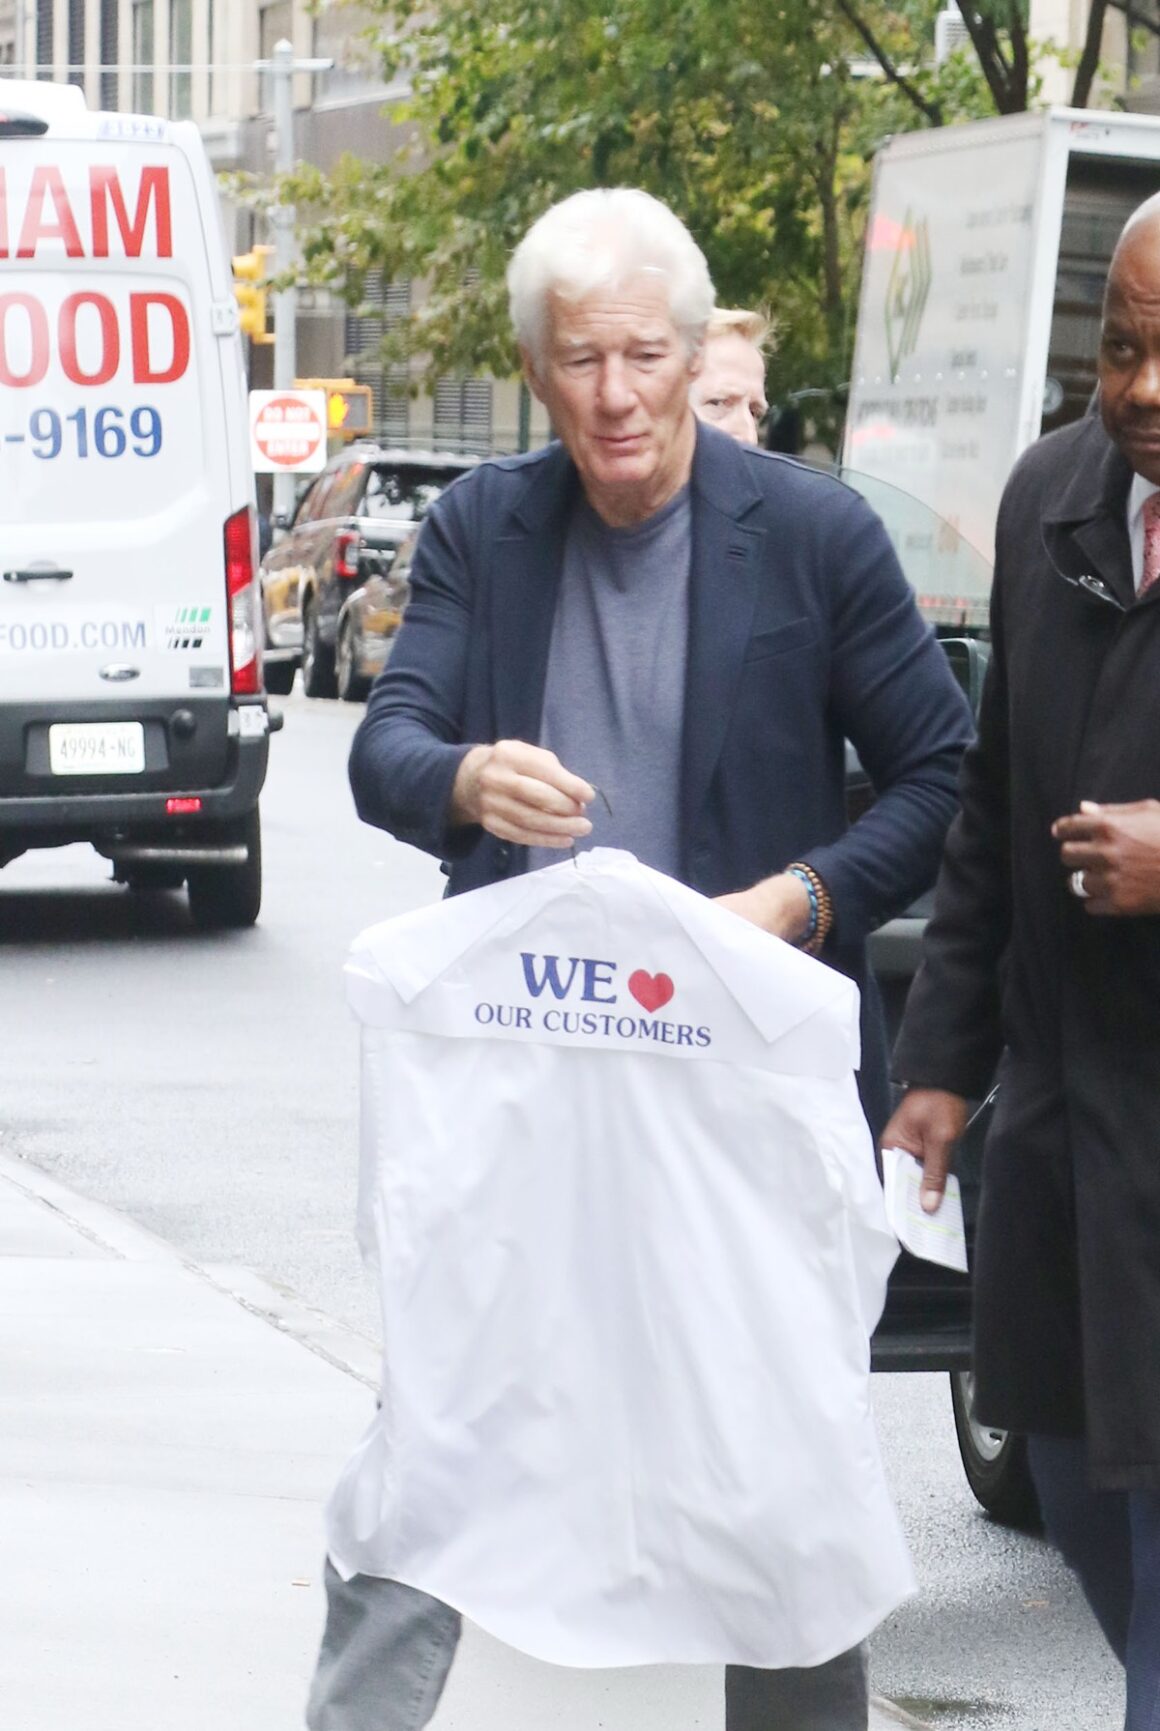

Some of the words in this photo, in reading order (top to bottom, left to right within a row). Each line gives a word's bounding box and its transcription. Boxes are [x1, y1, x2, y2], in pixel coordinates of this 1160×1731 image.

[0, 165, 173, 259] AM
[0, 404, 163, 460] -9169
[267, 439, 309, 456] ENTER
[519, 951, 618, 1004] WE
[474, 1002, 533, 1029] OUR
[543, 1009, 712, 1048] CUSTOMERS
